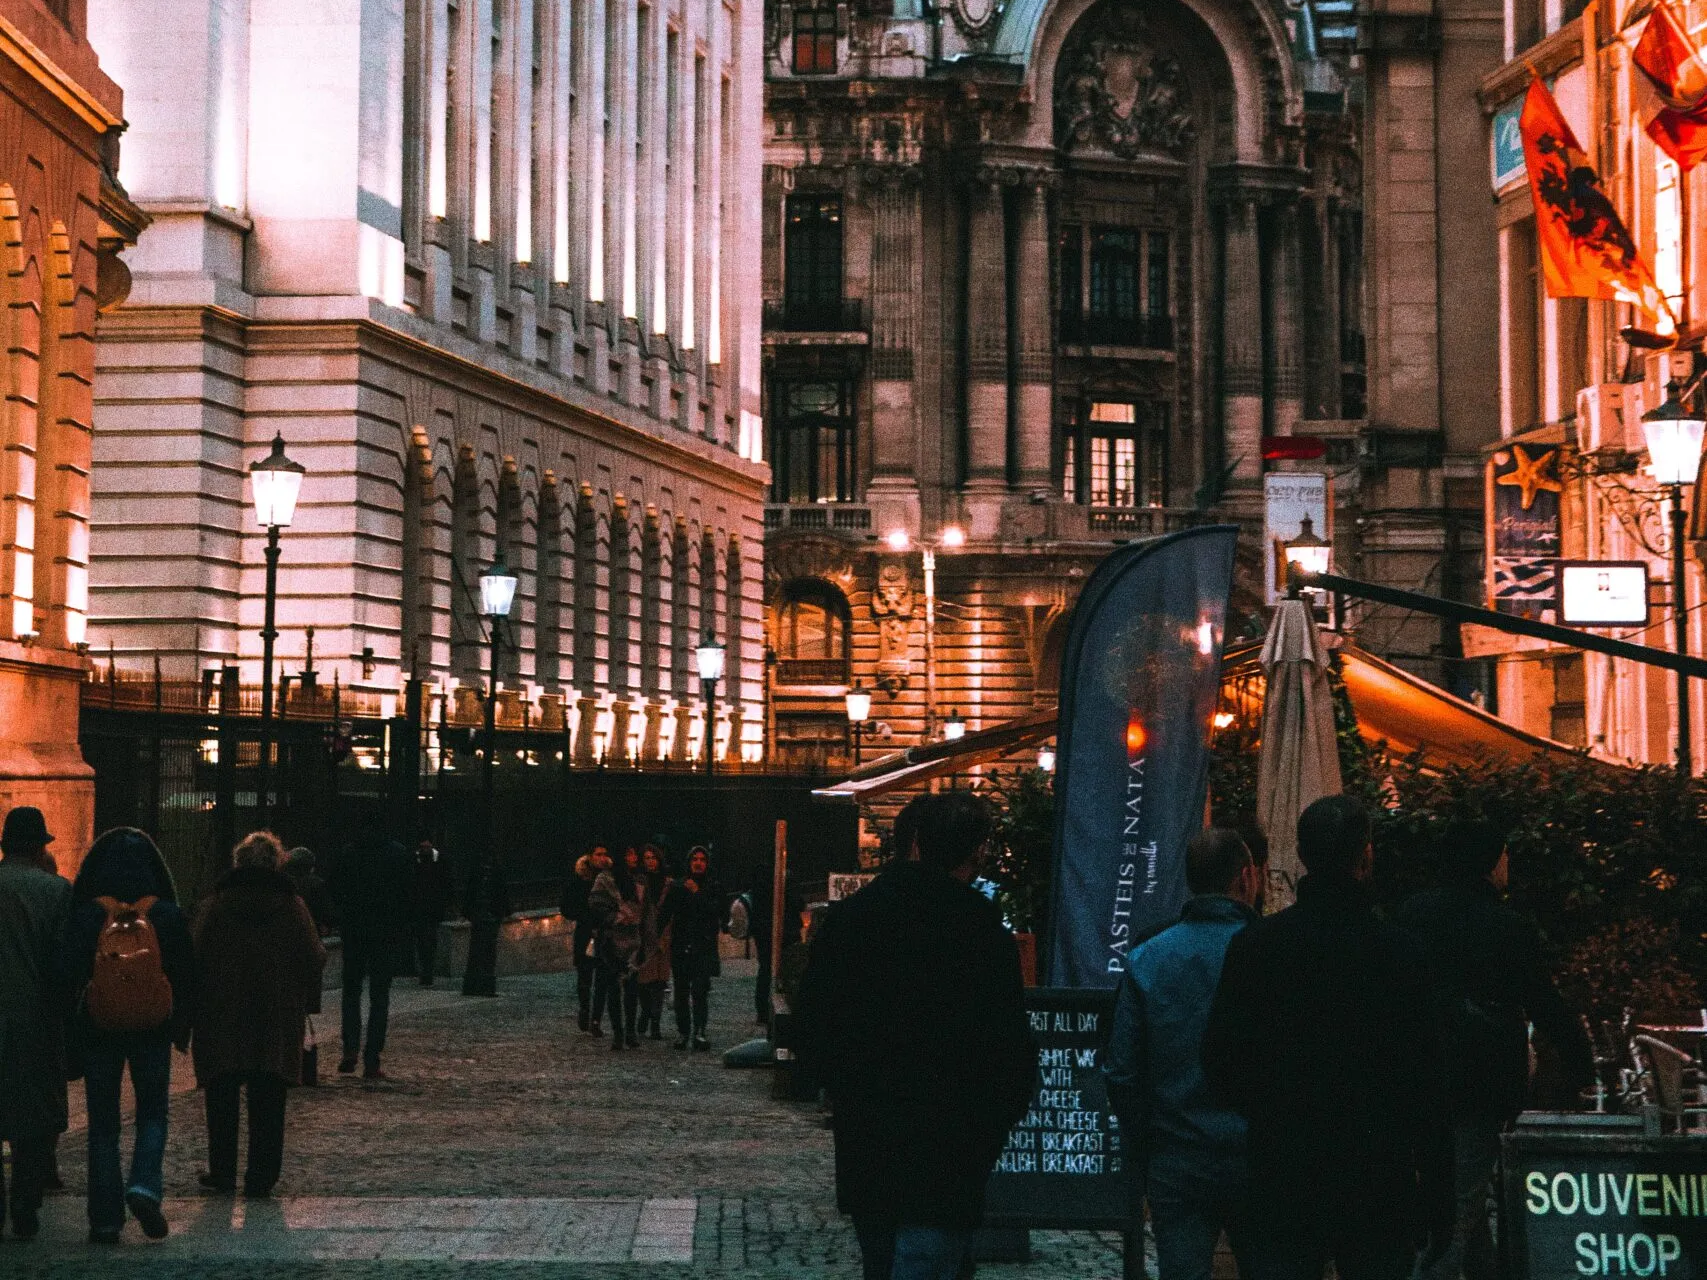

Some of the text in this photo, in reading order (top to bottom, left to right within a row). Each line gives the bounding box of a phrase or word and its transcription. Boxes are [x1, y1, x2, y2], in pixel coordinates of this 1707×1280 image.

[1107, 862, 1135, 973] PASTEIS
[1123, 758, 1145, 835] NATA
[1026, 1010, 1100, 1033] AST ALL DAY
[1040, 1068, 1073, 1088] WITH
[1039, 1088, 1083, 1110] CHEESE
[1043, 1109, 1054, 1128] &
[1056, 1110, 1101, 1131] CHEESE
[1003, 1130, 1036, 1150] NCH
[1041, 1131, 1105, 1152] BREAKFAST
[991, 1151, 1038, 1173] NGLISH
[1041, 1152, 1106, 1174] BREAKFAST
[1574, 1232, 1682, 1276] SHOP
